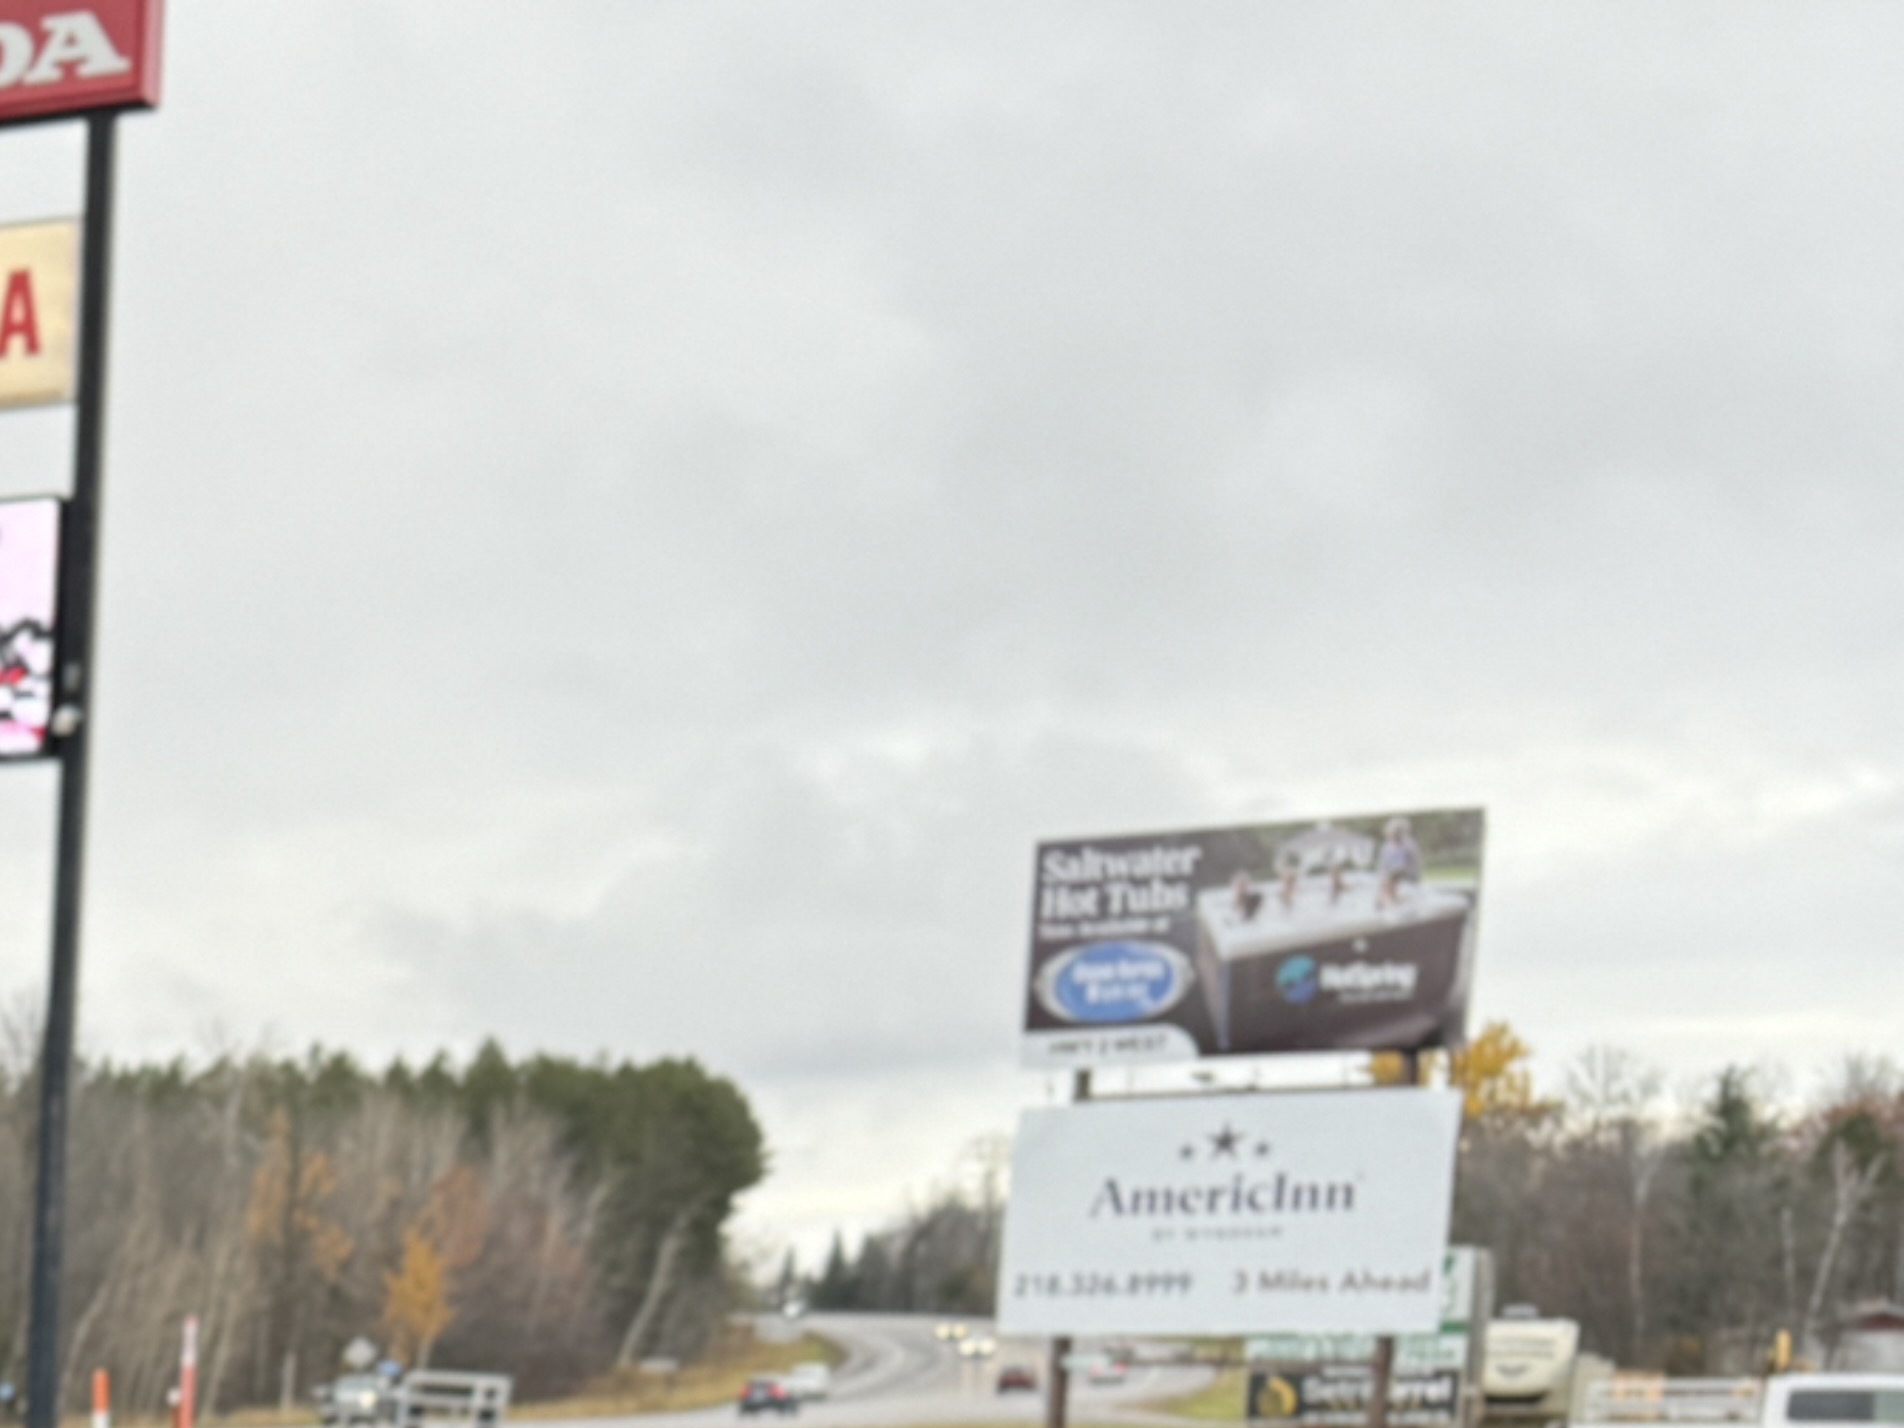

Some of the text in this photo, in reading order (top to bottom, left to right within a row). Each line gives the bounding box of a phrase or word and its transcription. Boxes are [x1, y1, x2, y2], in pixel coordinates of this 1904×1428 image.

[1043, 845, 1202, 882] Saltwater
[1040, 877, 1189, 919] Hot Tubs
[1090, 1171, 1355, 1219] AmericInn
[1257, 1269, 1330, 1295] Miles
[1339, 1269, 1431, 1294] Ahead
